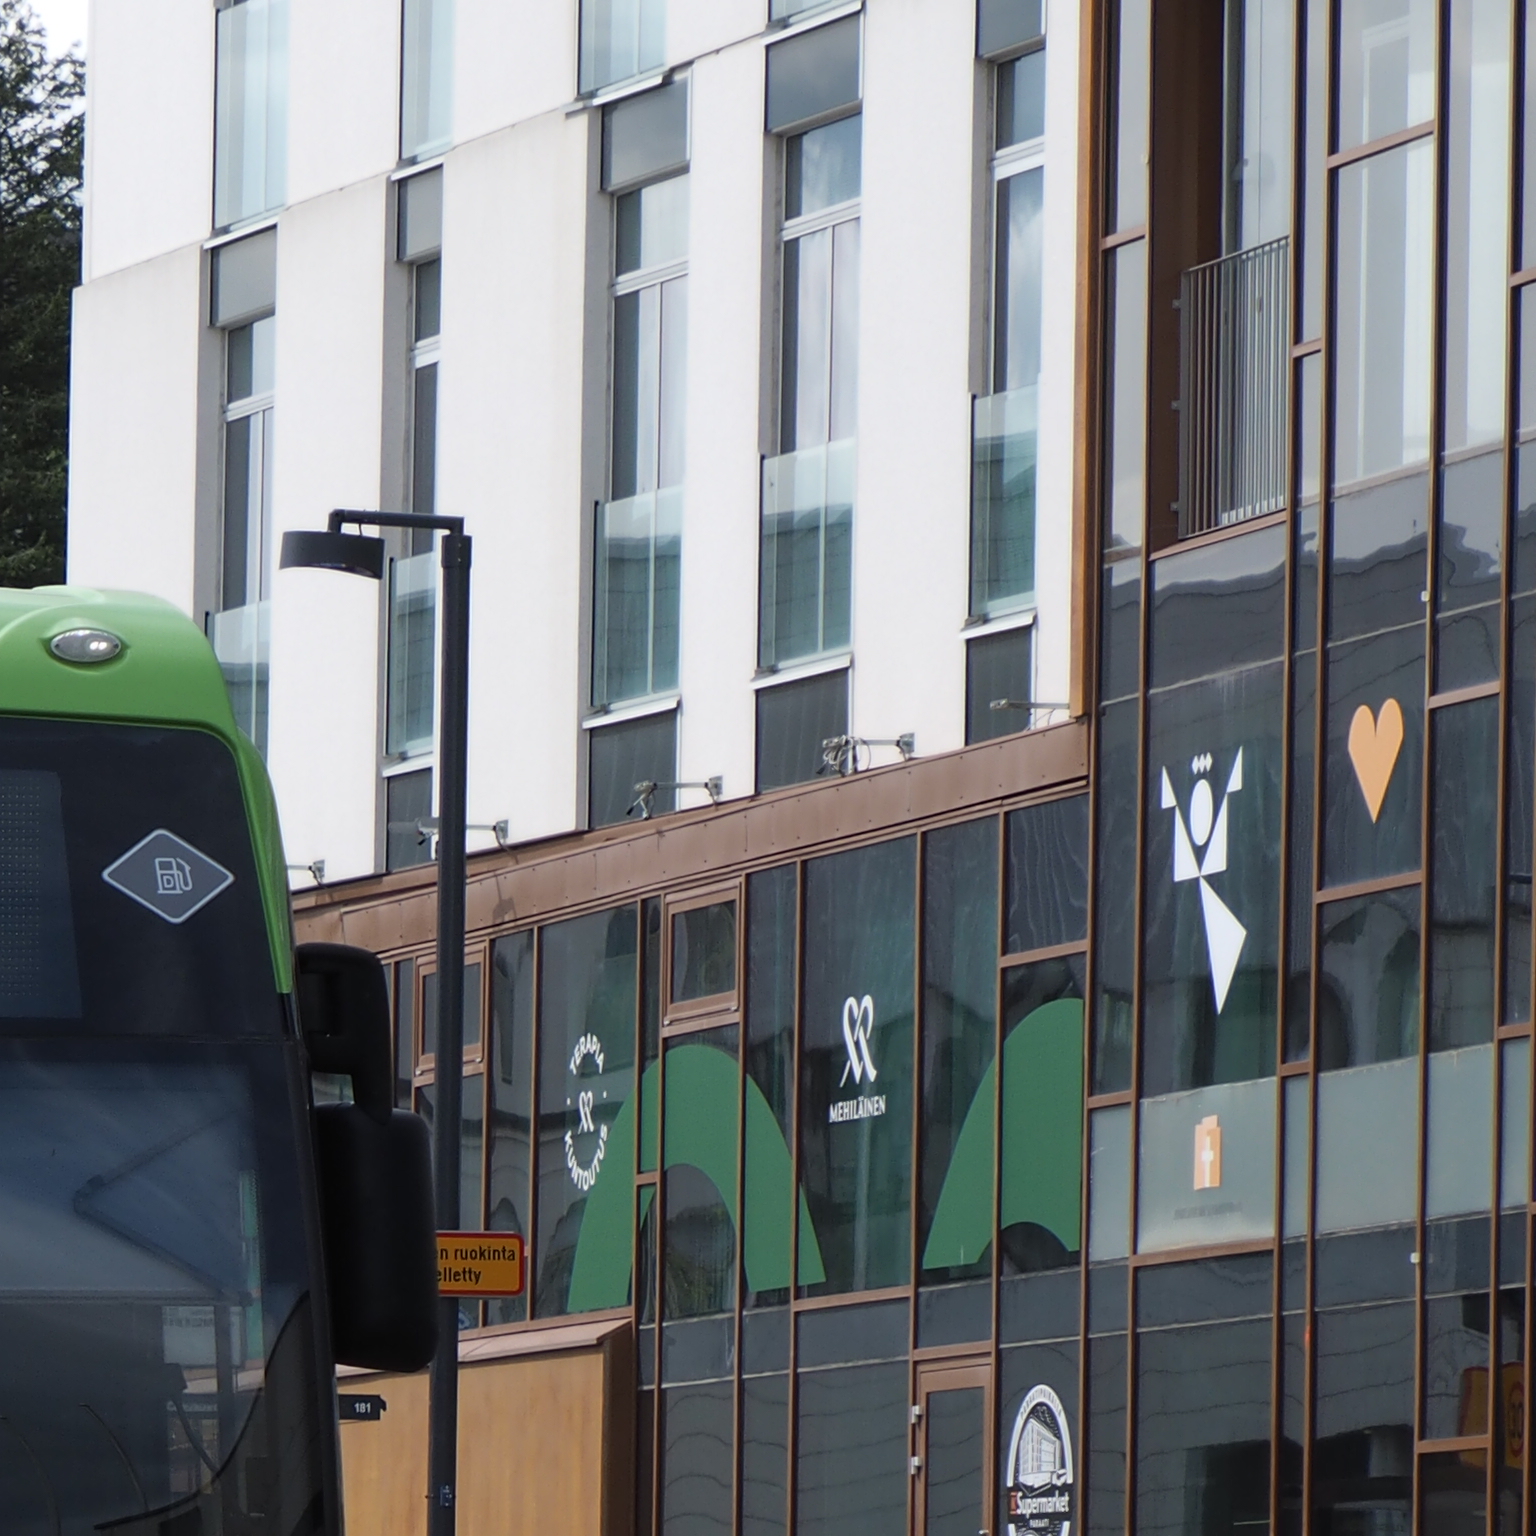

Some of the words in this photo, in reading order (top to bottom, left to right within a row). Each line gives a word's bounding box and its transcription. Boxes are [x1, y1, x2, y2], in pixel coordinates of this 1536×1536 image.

[569, 1033, 605, 1075] TERAPIA
[829, 1094, 886, 1123] MEHILÄINEN
[564, 1124, 608, 1192] KUNTOUTUS
[454, 1245, 516, 1261] ruokinta
[354, 1402, 371, 1413] 181
[1017, 1490, 1070, 1519] Supermarket
